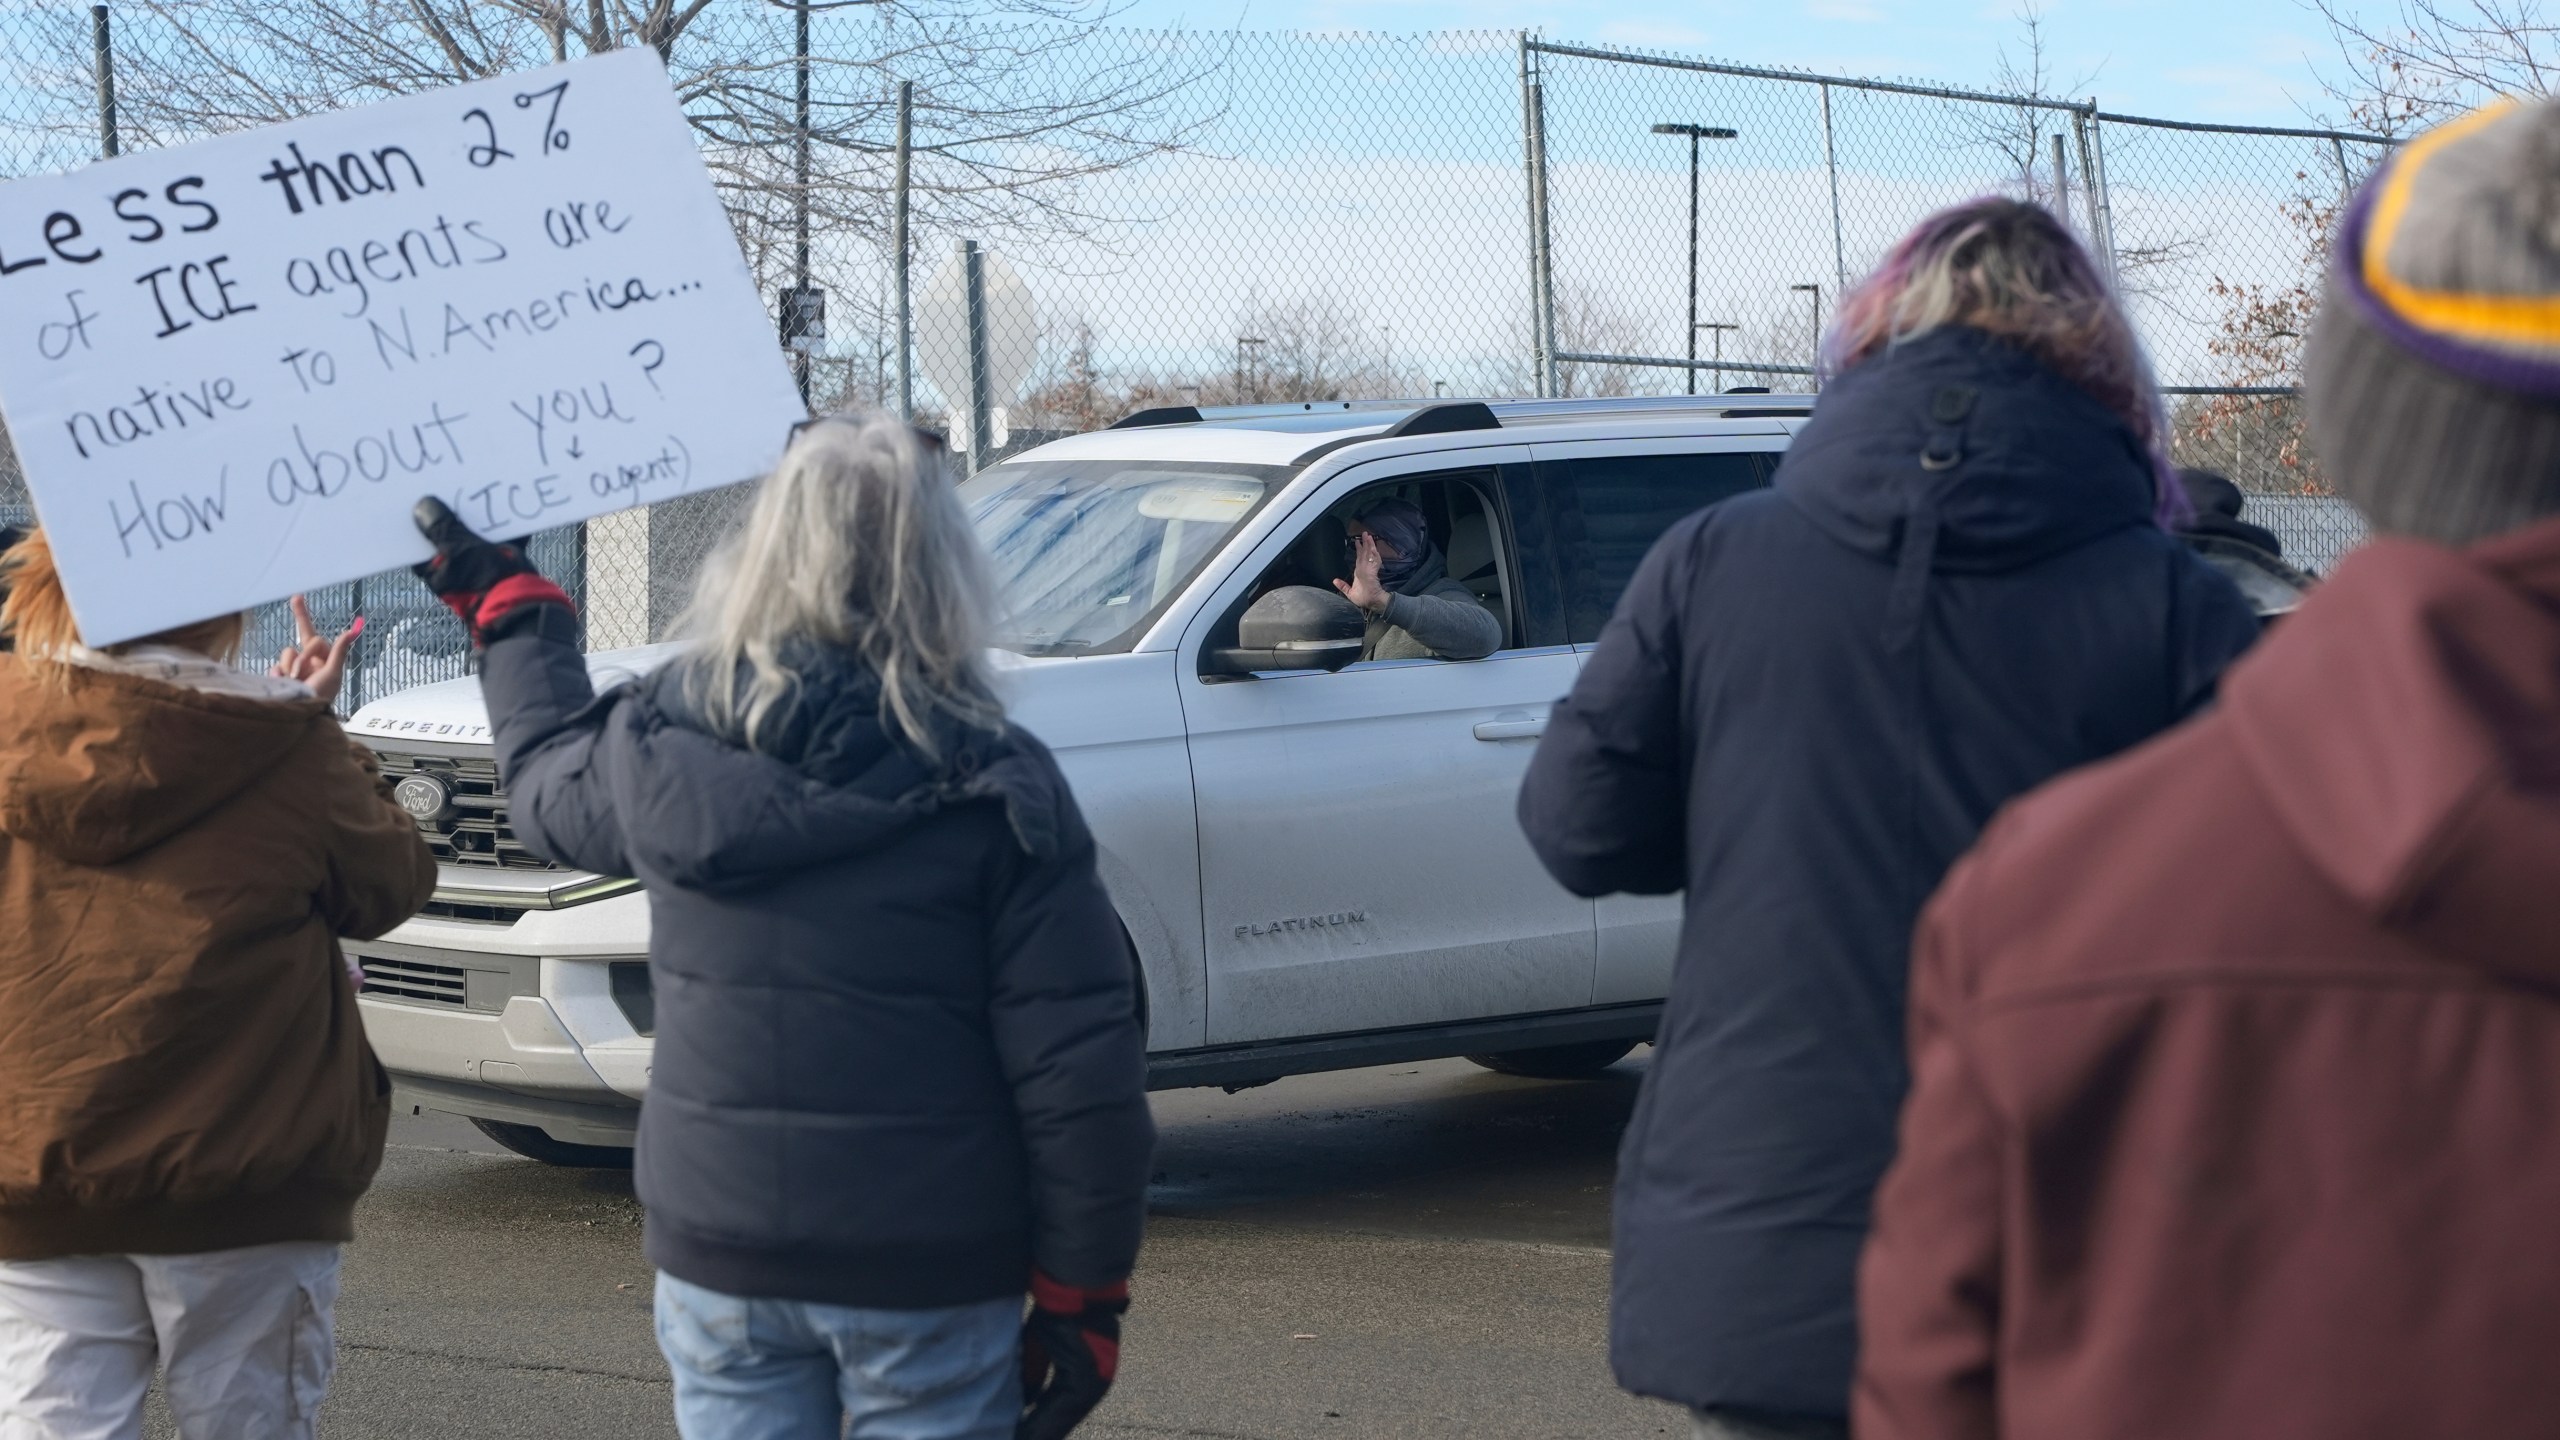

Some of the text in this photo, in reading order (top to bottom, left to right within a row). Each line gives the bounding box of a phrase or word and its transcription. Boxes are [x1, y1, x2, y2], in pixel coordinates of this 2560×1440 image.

[260, 141, 425, 214] than
[463, 80, 570, 168] 2%
[38, 200, 632, 361] of ICE agents are
[65, 376, 253, 459] native
[280, 347, 336, 393] to
[108, 463, 229, 558] How
[266, 402, 469, 507] about
[590, 434, 693, 508] agent)
[402, 784, 434, 813] Ford
[1234, 910, 1365, 938] PLATINUM
